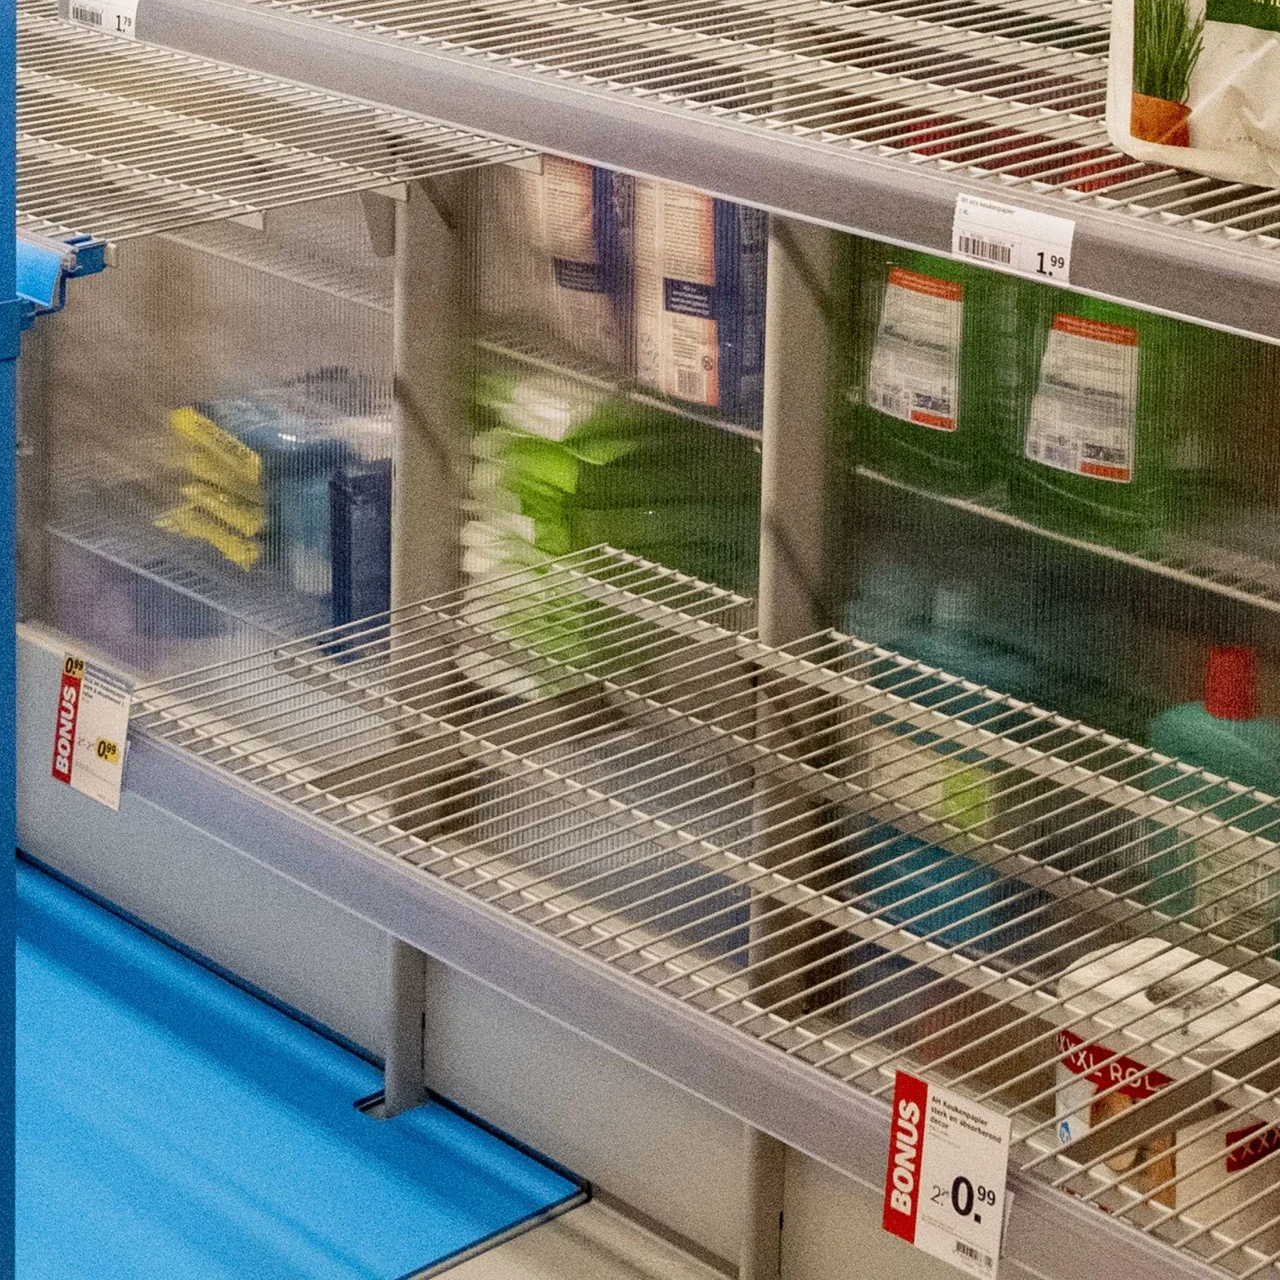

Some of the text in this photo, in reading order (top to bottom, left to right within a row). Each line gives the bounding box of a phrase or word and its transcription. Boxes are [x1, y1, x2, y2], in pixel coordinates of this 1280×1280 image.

[116, 14, 132, 33] 1.79
[1036, 251, 1065, 277] 1.99
[65, 657, 84, 675] 0.99
[55, 685, 77, 775] BONUS
[97, 740, 117, 759] 0.99
[929, 1116, 950, 1130] decor
[931, 1095, 988, 1126] AH Keukenpapier
[931, 1106, 948, 1121] sterk
[949, 1116, 958, 1125] en
[959, 1120, 1002, 1144] absorberend
[890, 1099, 920, 1215] BONUS
[951, 1176, 996, 1224] 0.99
